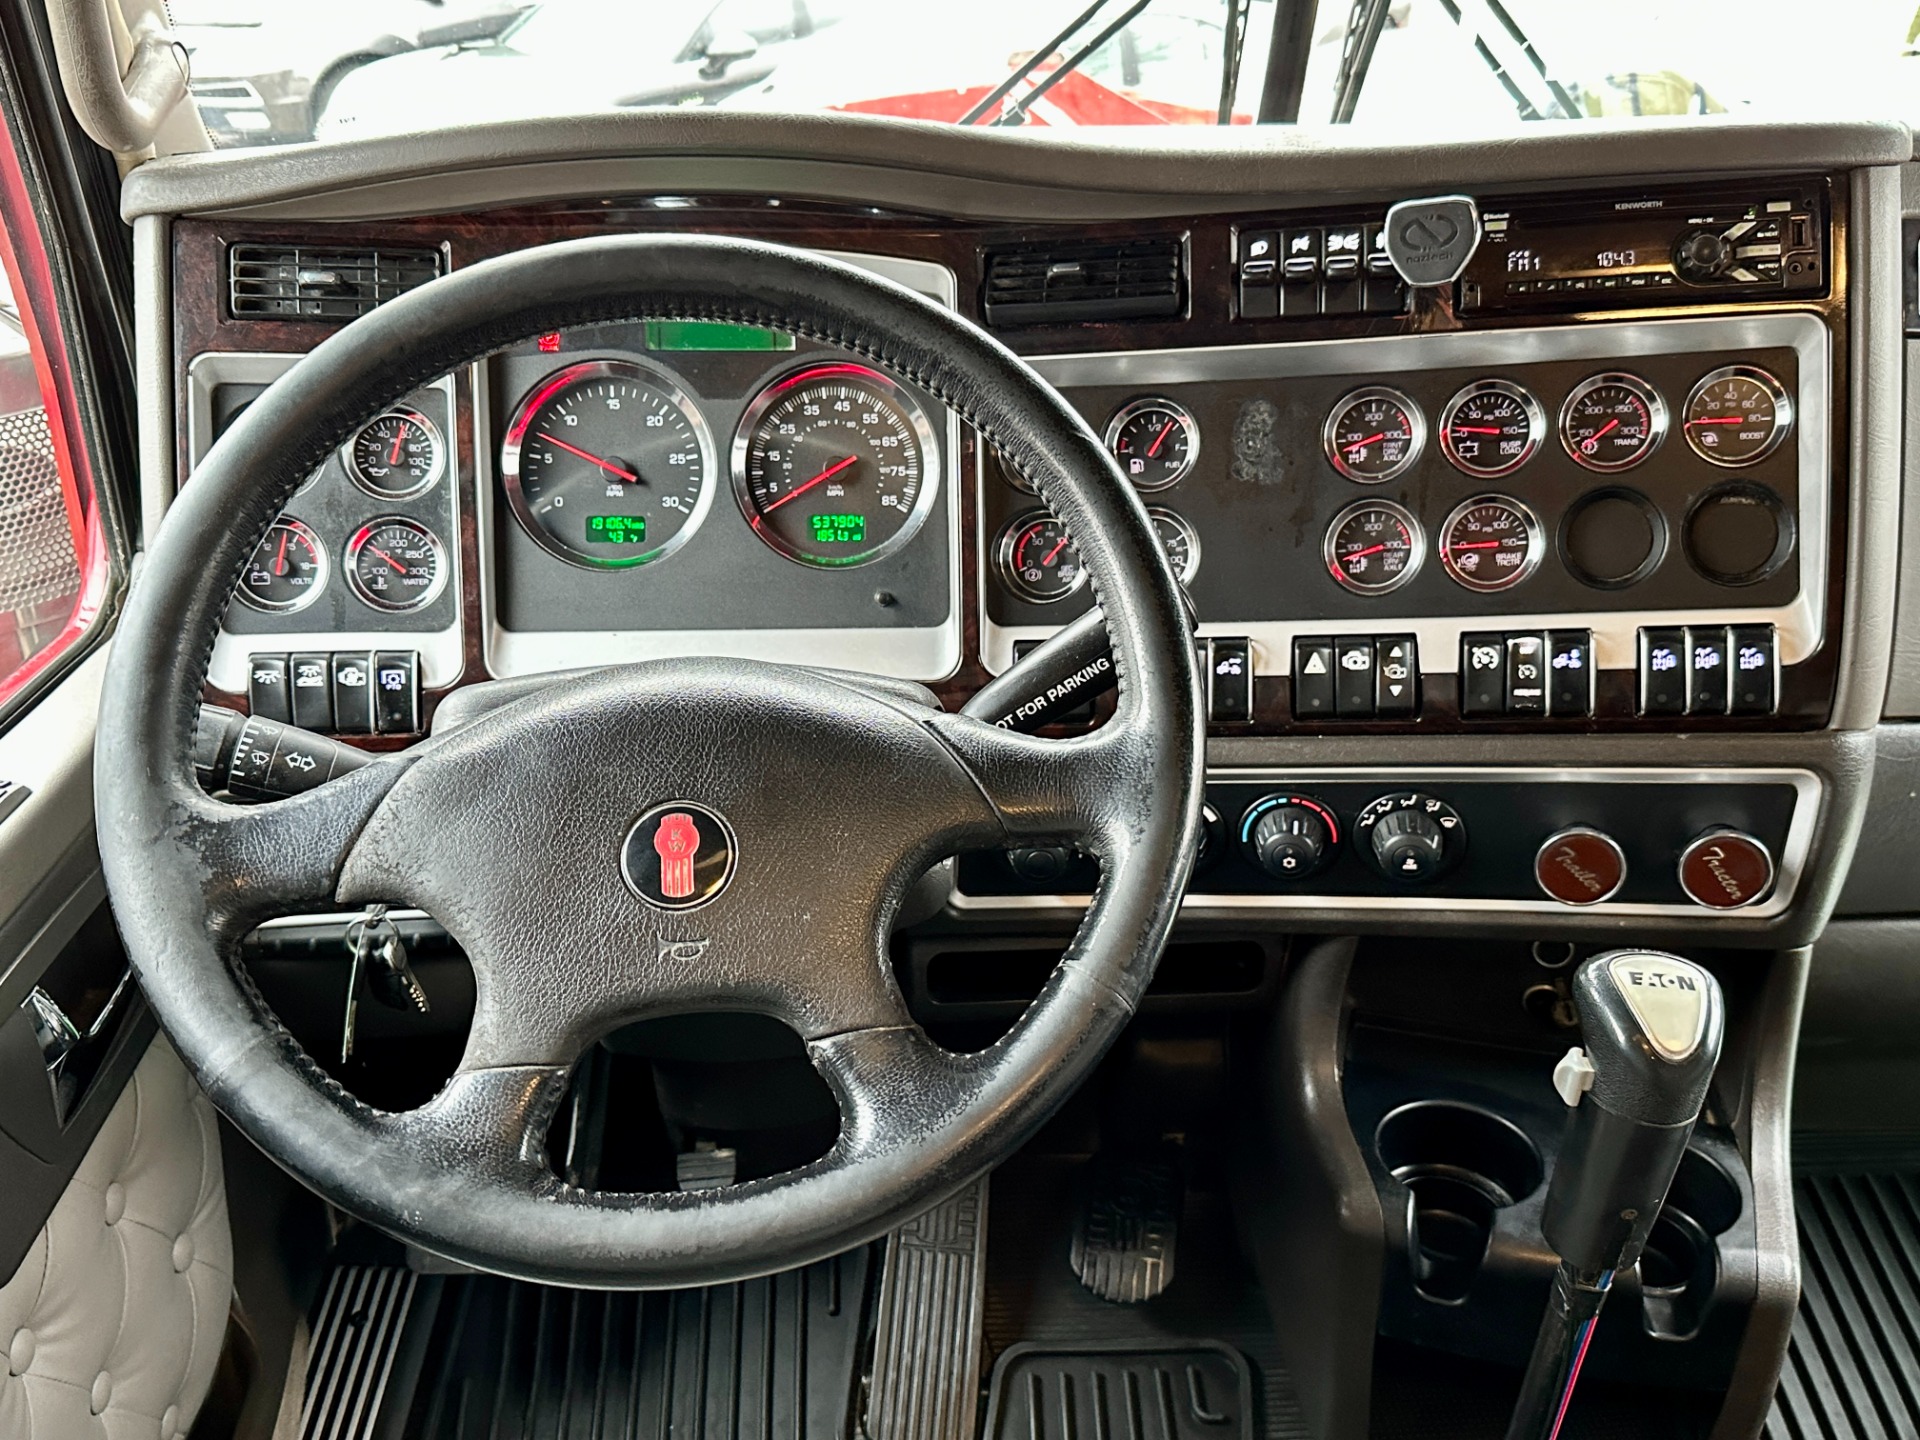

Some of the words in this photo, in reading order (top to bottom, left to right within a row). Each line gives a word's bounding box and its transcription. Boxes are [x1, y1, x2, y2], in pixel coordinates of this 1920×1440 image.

[1615, 201, 1663, 210] KENWORTH
[1406, 252, 1453, 264] naztech
[1724, 392, 1738, 400] 40
[606, 399, 620, 410] 15
[834, 402, 850, 412] 45
[1614, 404, 1633, 413] 250
[1707, 401, 1720, 410] 20
[1742, 400, 1756, 408] 60
[804, 405, 820, 416] 35
[1468, 410, 1482, 419] 50
[1494, 408, 1510, 418] 100
[1584, 406, 1604, 414] 200
[564, 415, 578, 426] 10
[646, 416, 663, 426] 20
[862, 414, 878, 424] 55
[1364, 412, 1384, 421] 200
[1748, 414, 1762, 422] 80
[780, 424, 796, 434] 25
[1148, 424, 1161, 432] 1/2
[1502, 426, 1518, 434] 150
[1578, 428, 1594, 437] 150
[1620, 426, 1639, 435] 300
[1347, 433, 1362, 442] 100
[1384, 430, 1402, 439] 300
[1740, 432, 1766, 440] BOOST
[882, 436, 898, 446] 65
[409, 444, 422, 452] 80
[544, 454, 552, 464] 5
[669, 454, 686, 464] 25
[768, 451, 780, 461] 15
[408, 458, 424, 466] 100
[890, 466, 906, 476] 75
[770, 483, 778, 492] 5
[554, 497, 564, 507] 0
[662, 497, 679, 508] 30
[882, 496, 898, 506] 85
[812, 516, 864, 528] 537904
[1364, 522, 1382, 531] 200
[1468, 522, 1480, 531] 50
[1492, 520, 1509, 529] 100
[608, 530, 624, 543] 43
[1384, 540, 1402, 549] 300
[1502, 538, 1517, 546] 150
[263, 543, 272, 551] 12
[1347, 543, 1362, 551] 100
[406, 550, 424, 558] 250
[994, 715, 1015, 731] OT
[1016, 696, 1048, 721] FOR
[1046, 656, 1110, 702] PARKING
[1555, 846, 1601, 893] Trailer
[1702, 846, 1742, 900] Tractor
[1628, 972, 1696, 991] EATON
